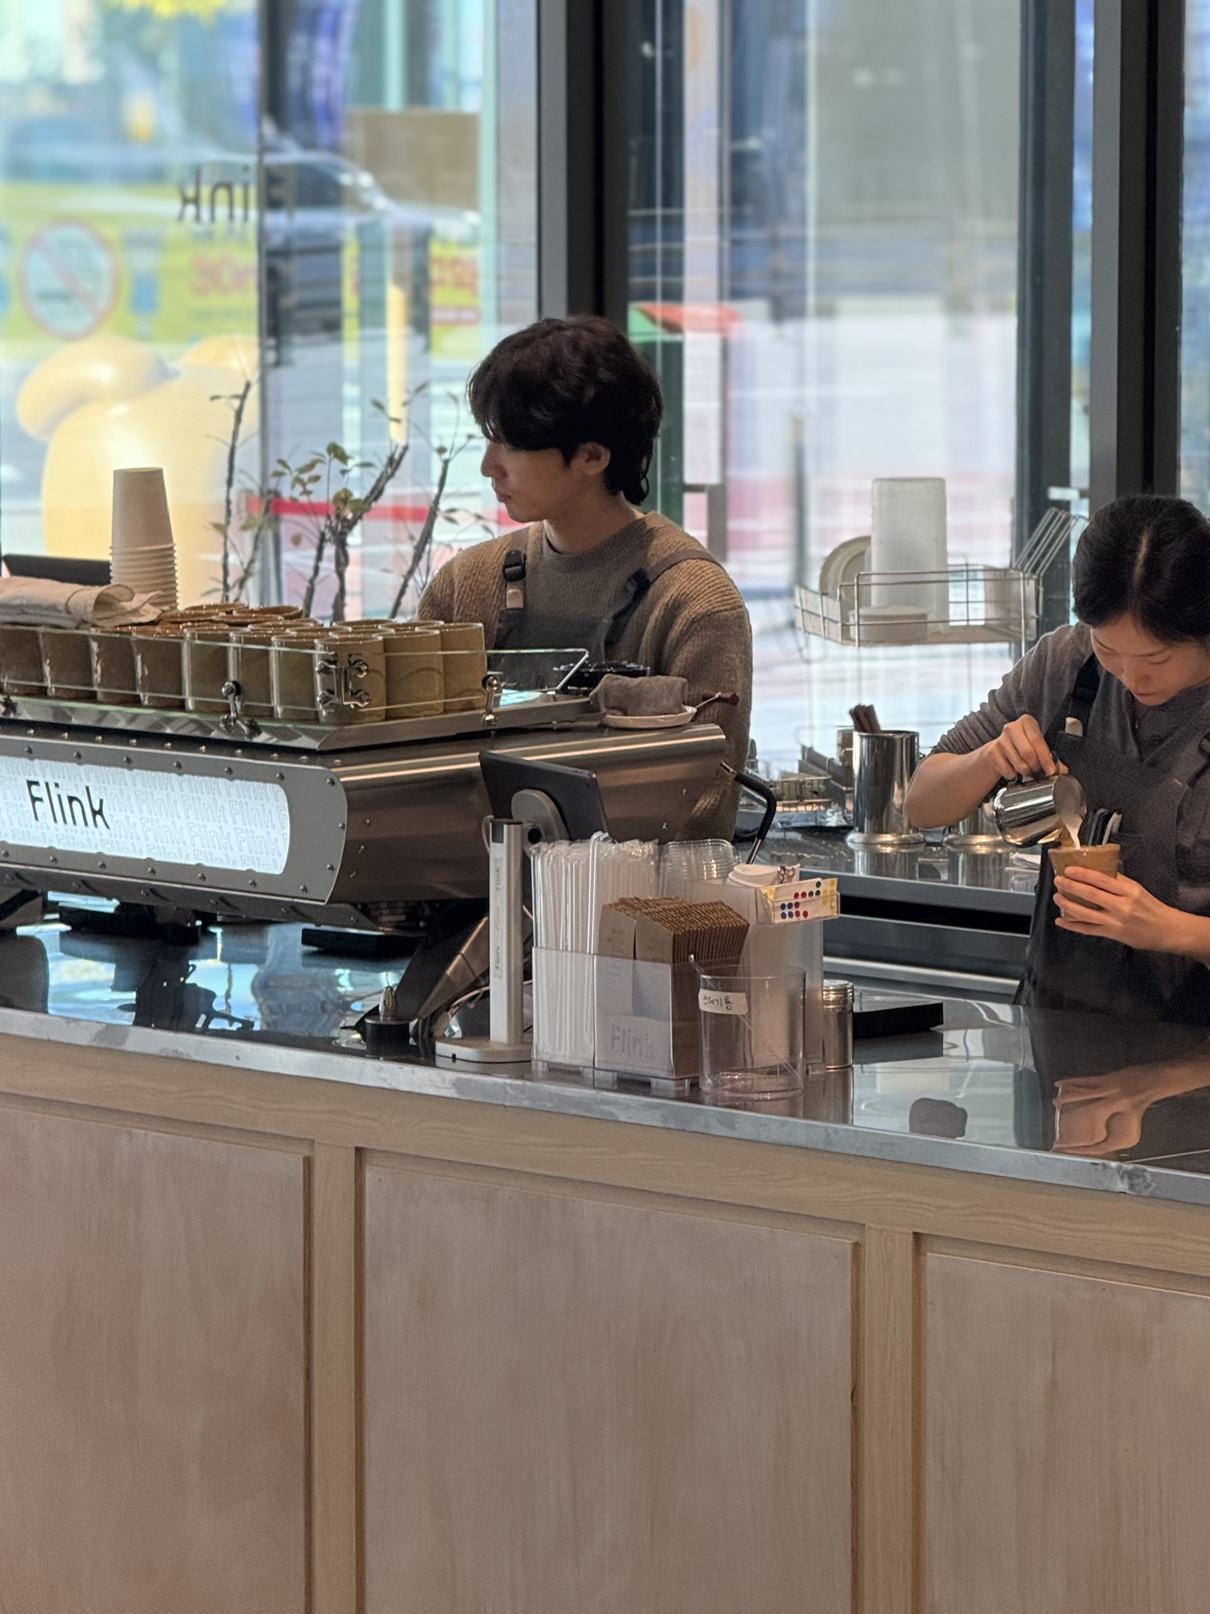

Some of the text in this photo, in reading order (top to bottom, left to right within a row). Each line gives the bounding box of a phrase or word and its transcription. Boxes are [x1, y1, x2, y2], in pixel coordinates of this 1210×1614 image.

[26, 779, 111, 830] Flink
[135, 790, 180, 820] Flink
[181, 795, 228, 824] Flink
[229, 800, 276, 829] Flink
[140, 817, 187, 846] Flink
[187, 822, 234, 852] Flink
[234, 827, 282, 857] Flink
